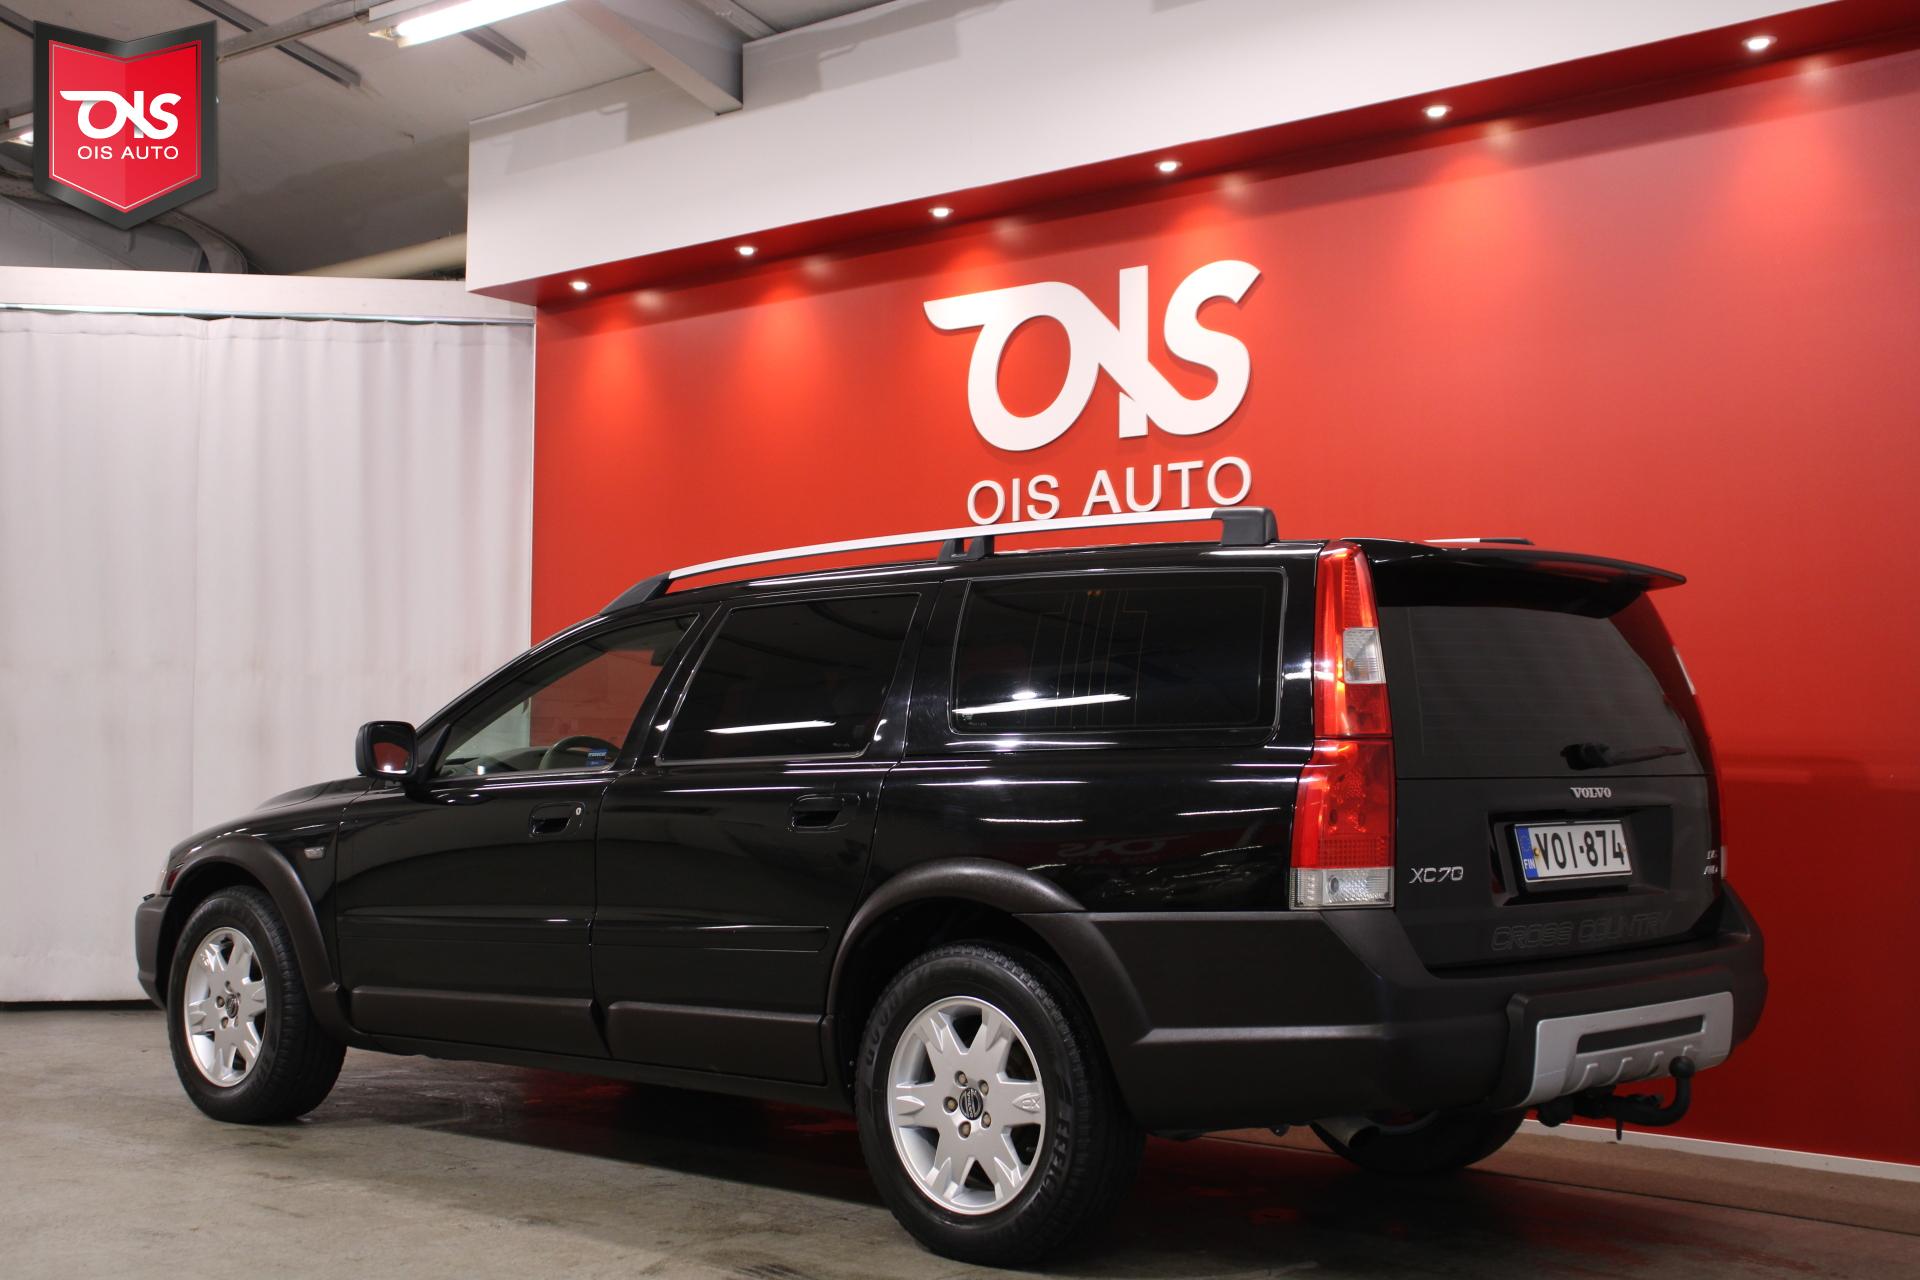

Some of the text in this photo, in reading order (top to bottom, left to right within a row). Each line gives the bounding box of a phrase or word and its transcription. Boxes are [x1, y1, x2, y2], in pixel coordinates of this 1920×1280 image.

[923, 259, 1261, 452] OIS
[966, 456, 1252, 525] OIS AUTO
[1570, 787, 1612, 798] VOLVO
[1523, 859, 1536, 869] FIN
[1534, 829, 1625, 871] VOI-874
[1408, 865, 1464, 884] XC70
